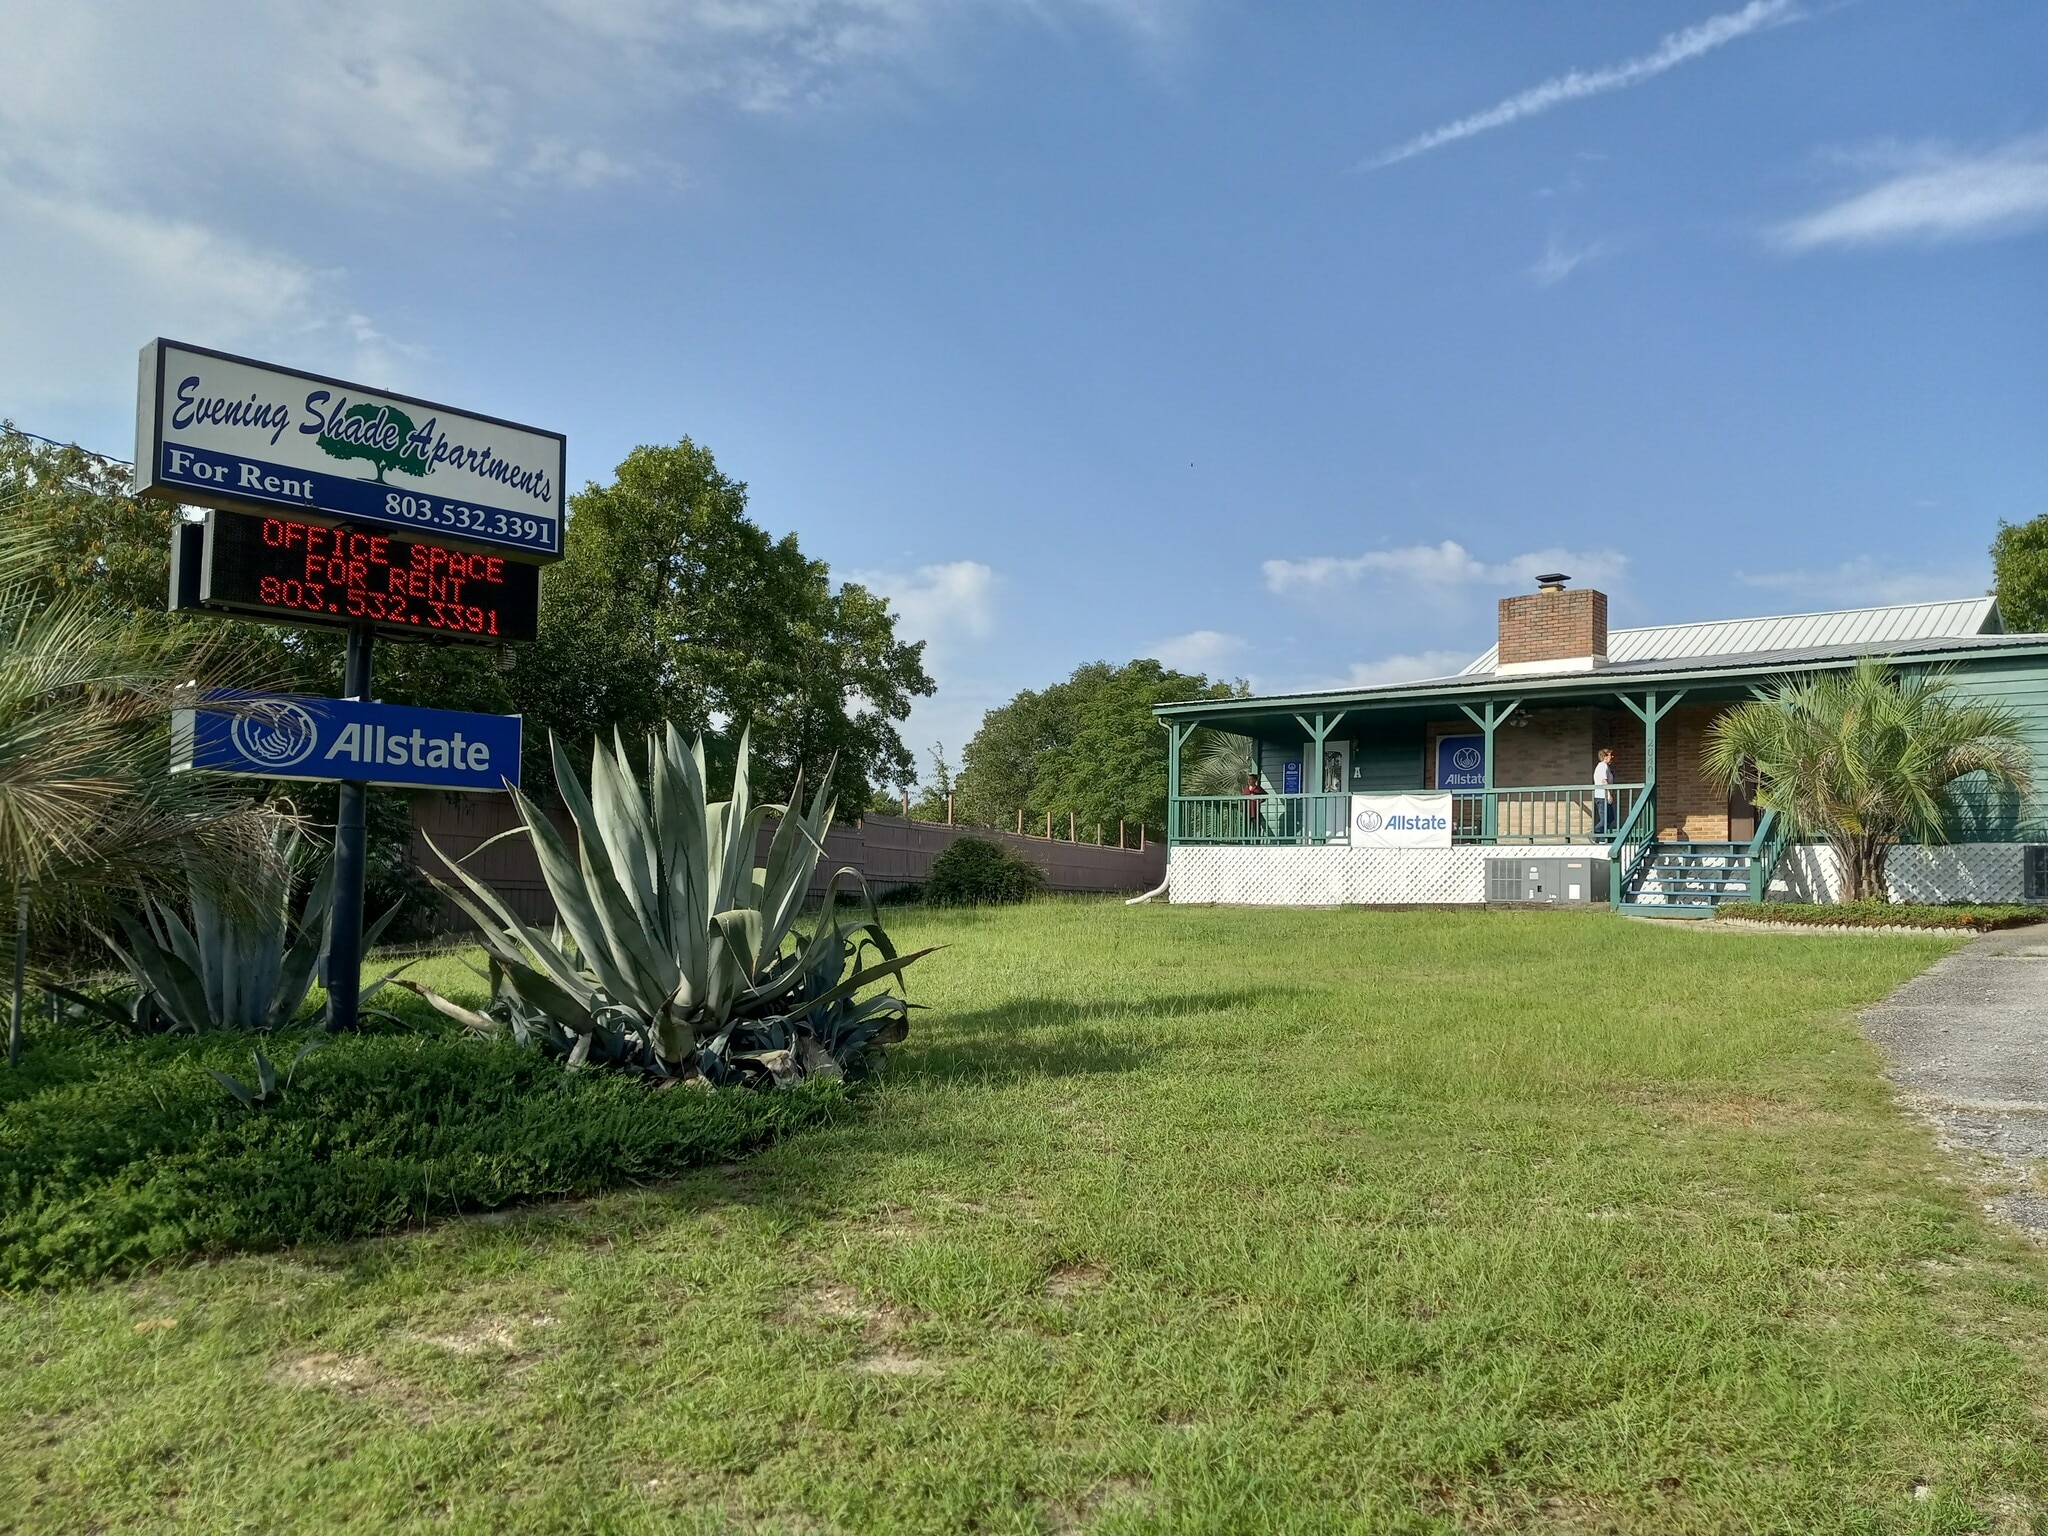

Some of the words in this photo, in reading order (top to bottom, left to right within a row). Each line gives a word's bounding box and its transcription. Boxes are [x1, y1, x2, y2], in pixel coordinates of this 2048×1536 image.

[172, 376, 290, 446] Evening
[298, 390, 399, 451] Shade
[400, 417, 552, 503] Apartments
[168, 449, 229, 482] For
[237, 463, 314, 499] Rent
[385, 493, 551, 544] 803.532.3391
[262, 518, 390, 564] OFFICE
[410, 544, 504, 584] SPACE
[305, 554, 368, 590] FOR
[388, 567, 466, 602] RENT
[260, 576, 499, 636] 803.532.3391
[324, 723, 491, 771] Allstate
[1353, 766, 1362, 778] A
[1384, 815, 1447, 830] Allstate
